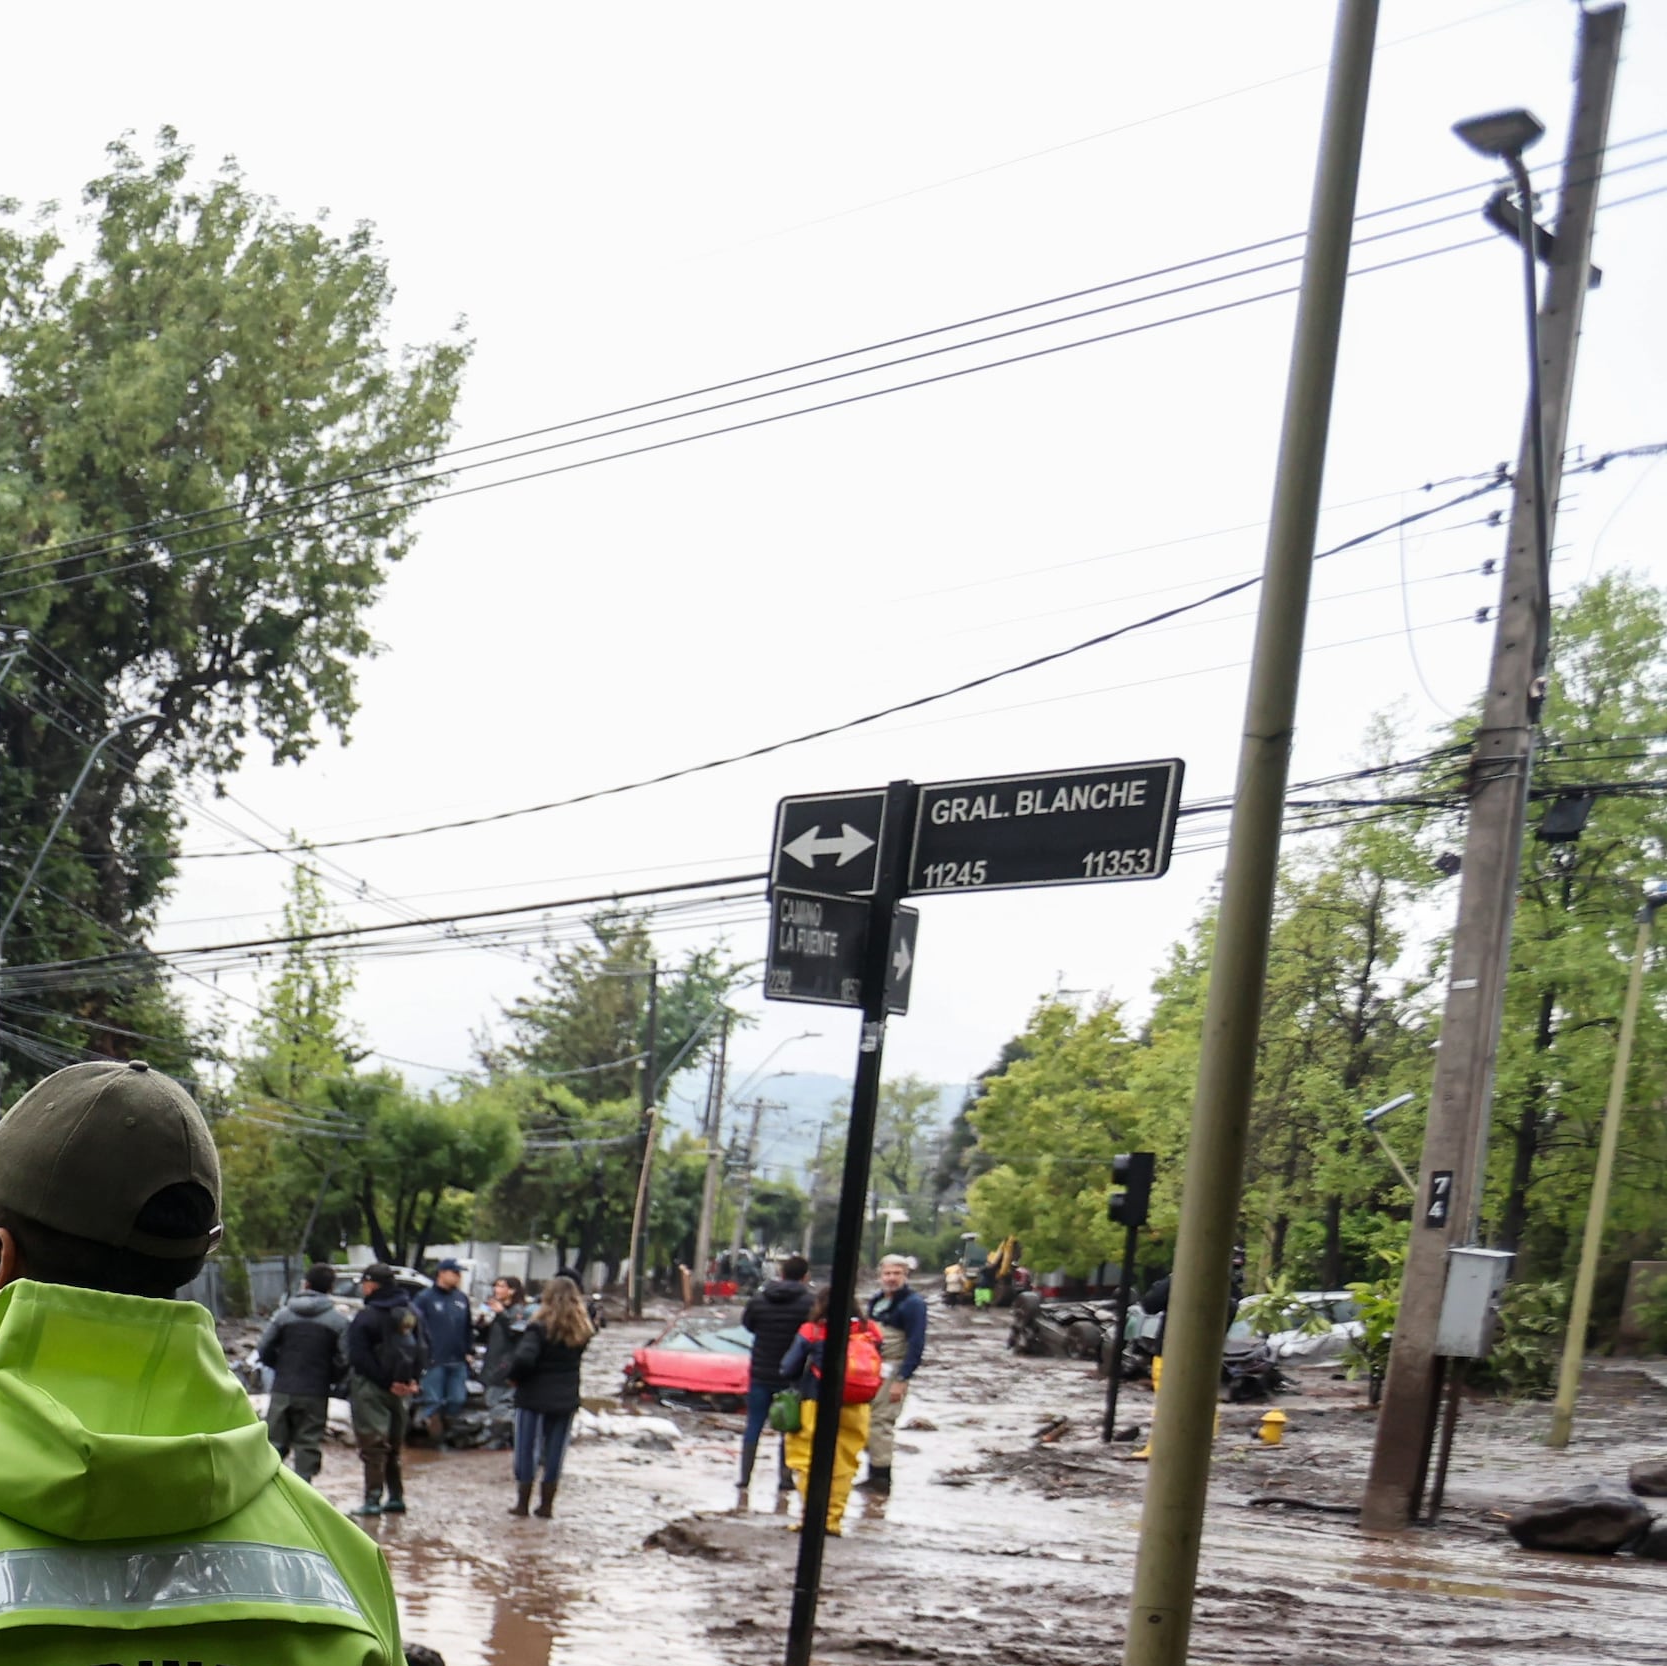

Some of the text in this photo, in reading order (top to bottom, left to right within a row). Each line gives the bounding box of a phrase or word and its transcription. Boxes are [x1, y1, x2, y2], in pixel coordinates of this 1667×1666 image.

[931, 779, 1148, 826] GRAL. BLANCHE
[922, 848, 1151, 889] 11245 11353
[780, 898, 822, 927] CAMINO
[779, 925, 838, 957] LA FUENTE
